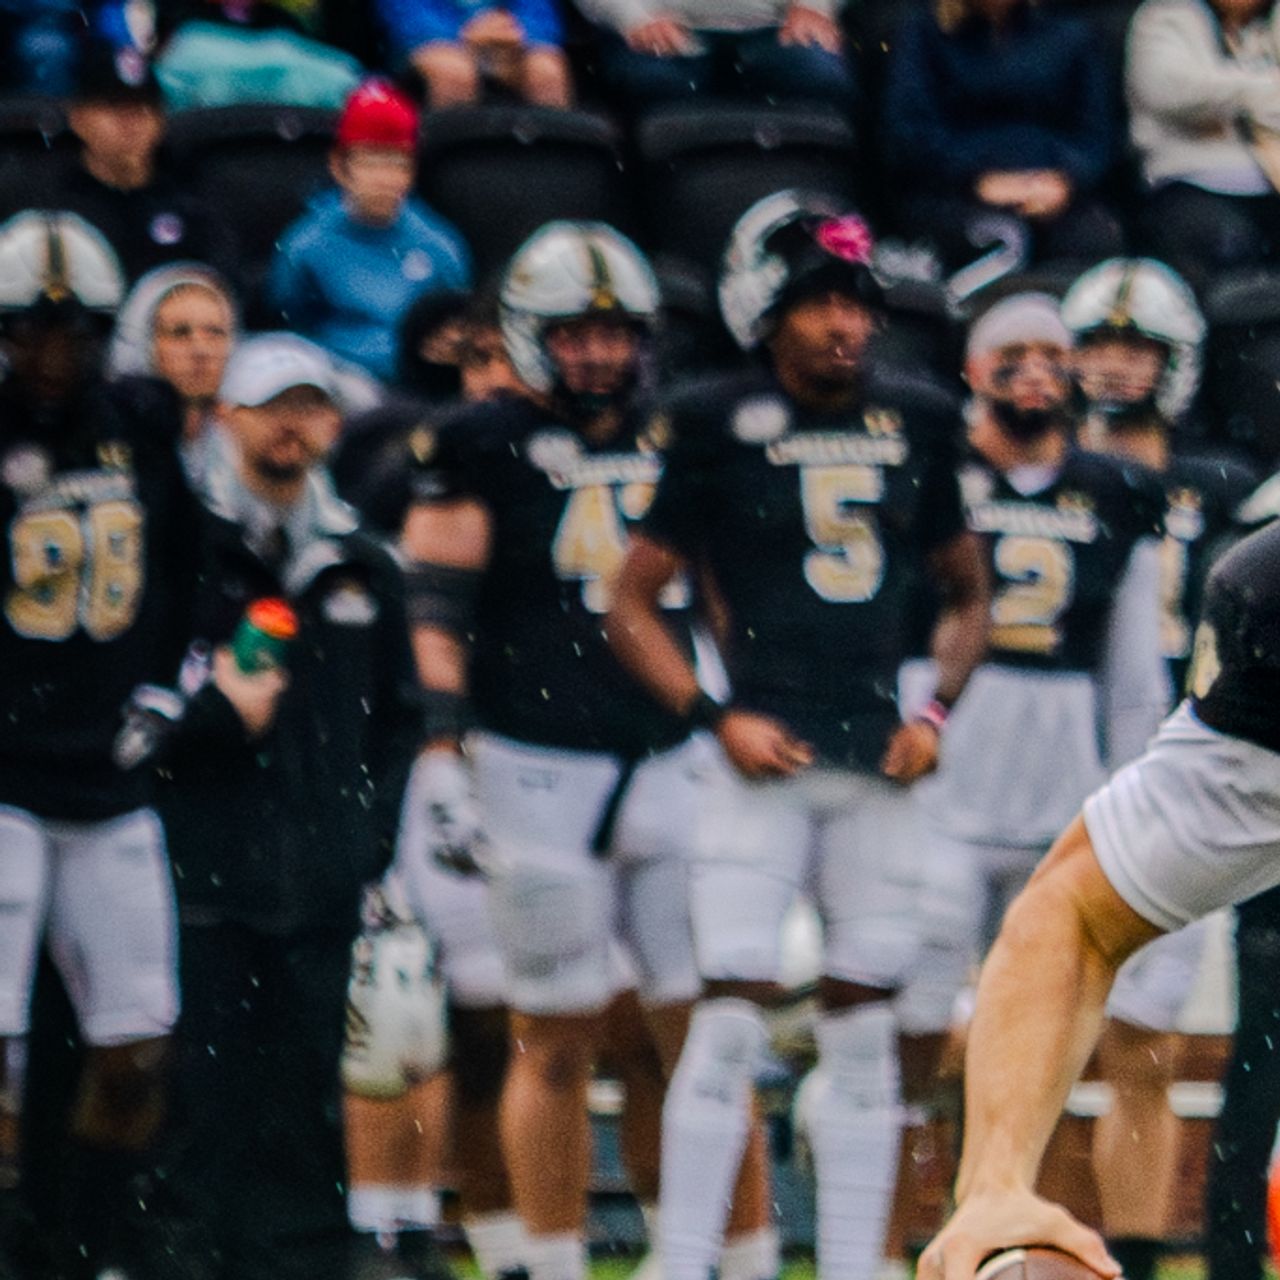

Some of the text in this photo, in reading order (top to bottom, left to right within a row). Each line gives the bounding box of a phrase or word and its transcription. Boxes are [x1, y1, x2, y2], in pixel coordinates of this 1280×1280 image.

[5, 502, 143, 641] 98
[800, 463, 884, 603] 5
[991, 534, 1075, 653] 2
